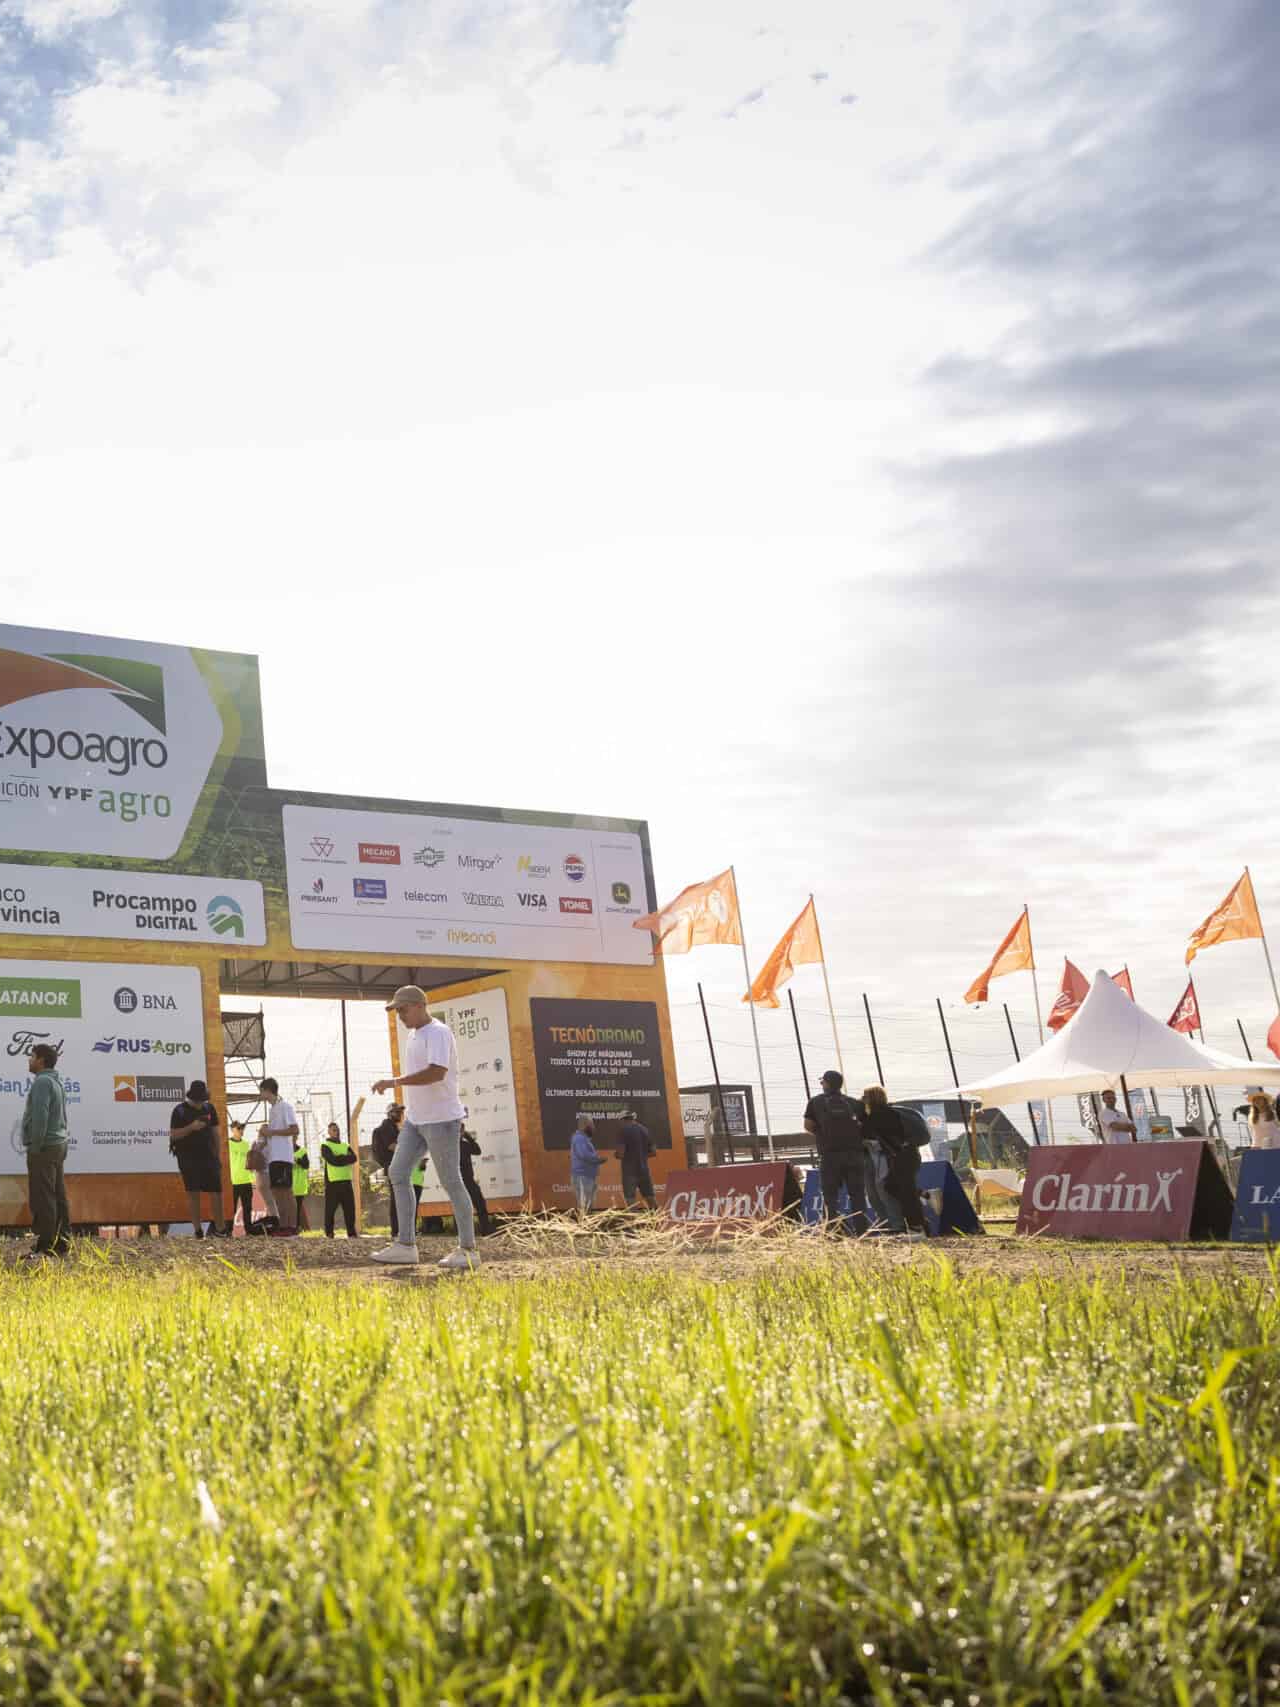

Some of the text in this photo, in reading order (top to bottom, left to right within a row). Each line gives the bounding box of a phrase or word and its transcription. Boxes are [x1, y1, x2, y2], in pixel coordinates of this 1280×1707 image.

[47, 784, 93, 801] YPF
[99, 788, 170, 822] agro
[458, 855, 496, 871] Mirgor
[92, 890, 197, 919] Procampo
[404, 890, 448, 903] telecom
[517, 893, 547, 907] VISA
[135, 914, 197, 931] DIGITAL
[0, 990, 69, 1006] ATANOR
[142, 995, 178, 1010] BNA
[458, 1008, 476, 1018] YPF
[459, 1017, 489, 1038] agro
[6, 1030, 64, 1057] Fod
[139, 1084, 183, 1100] Ternium
[1032, 1172, 1153, 1213] Clarín
[670, 1189, 752, 1222] Clarín
